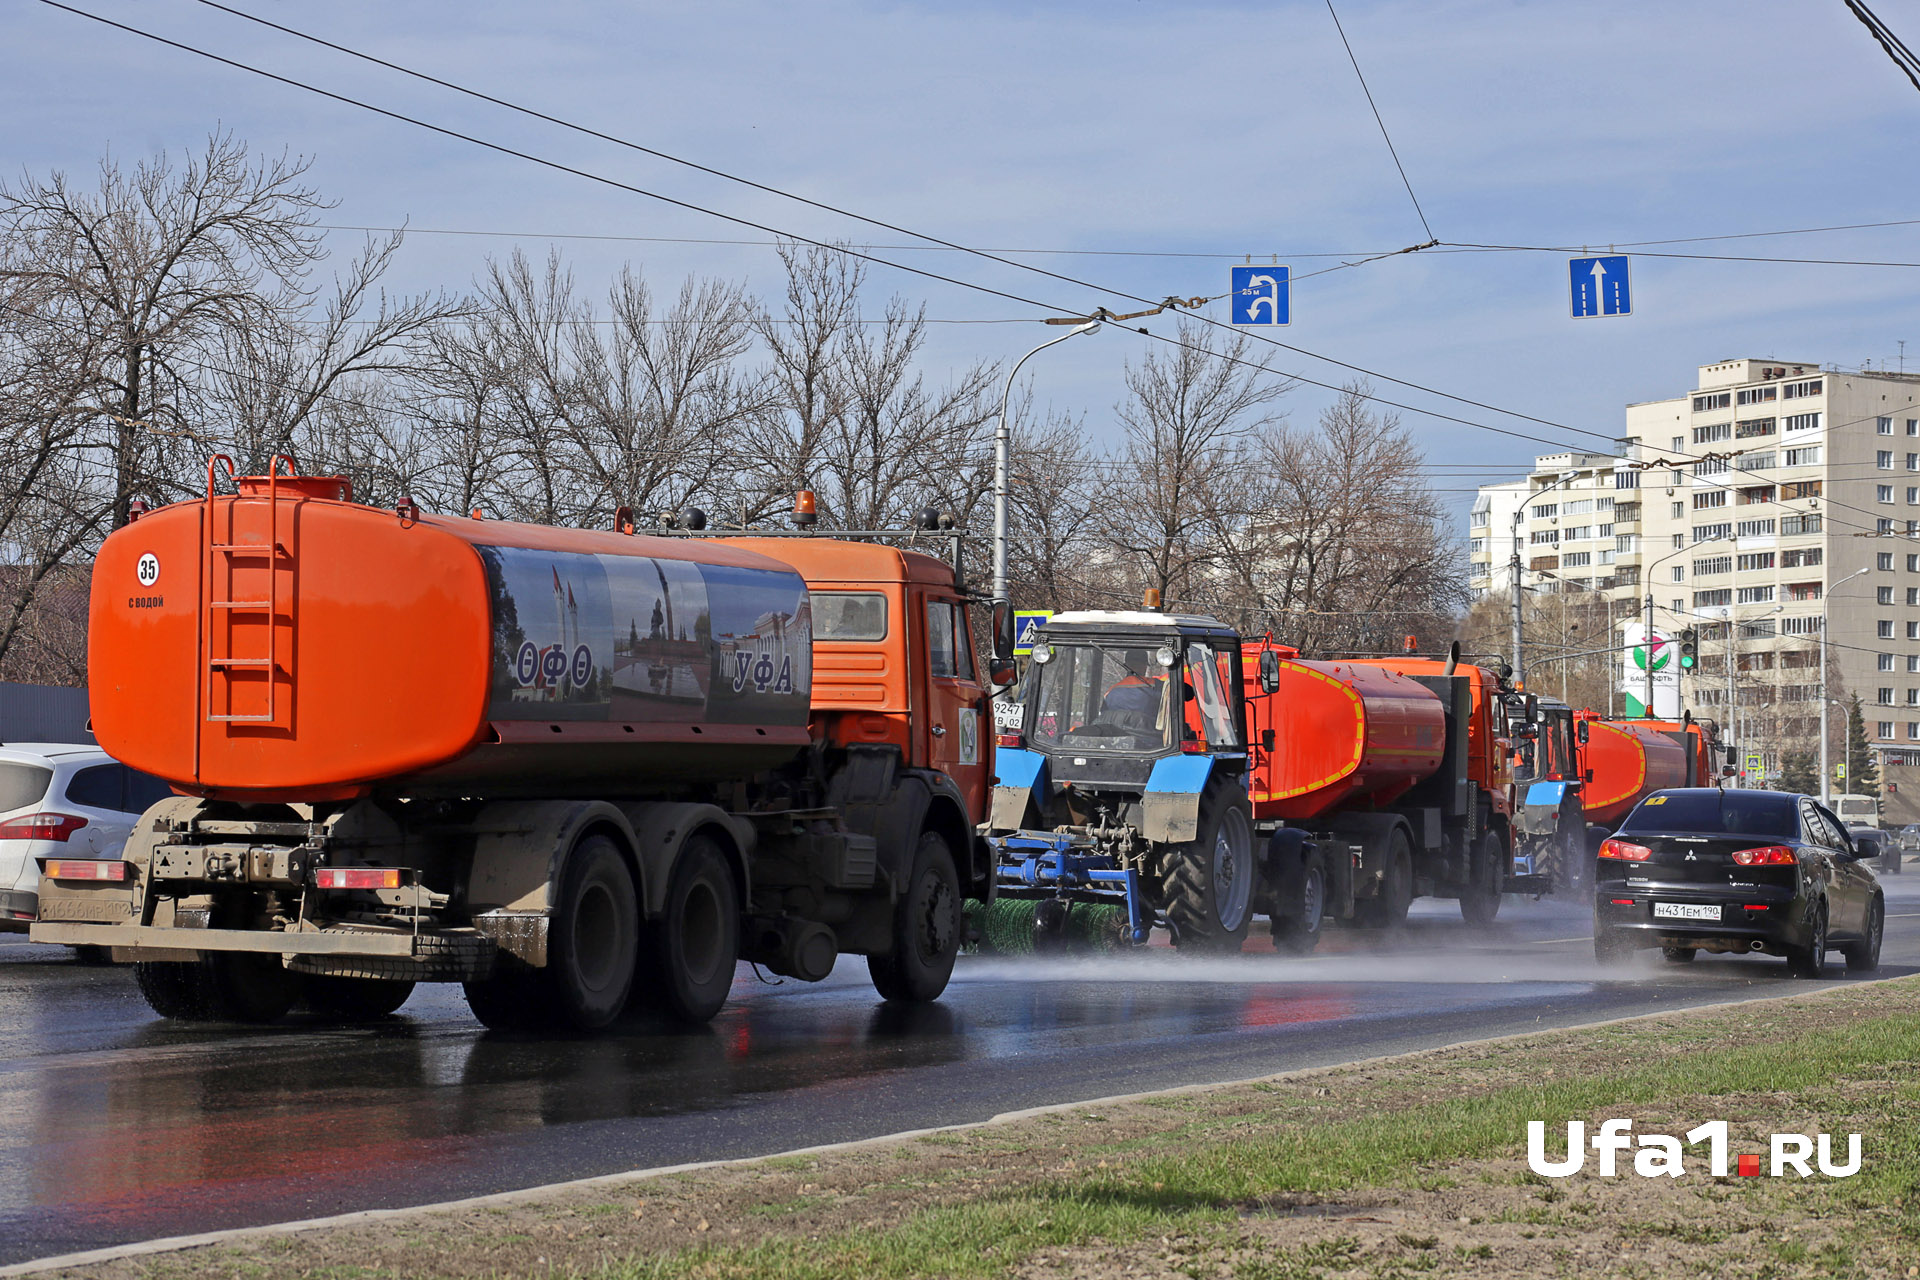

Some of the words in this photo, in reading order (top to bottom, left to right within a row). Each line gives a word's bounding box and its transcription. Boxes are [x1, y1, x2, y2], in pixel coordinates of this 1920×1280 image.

[140, 560, 156, 580] 35
[128, 597, 134, 608] С
[135, 594, 164, 609] ВОДОЙ
[733, 649, 792, 694] УФА
[994, 702, 1020, 715] 9247
[1009, 718, 1020, 727] 02
[107, 902, 131, 915] 102
[1702, 906, 1719, 915] 190
